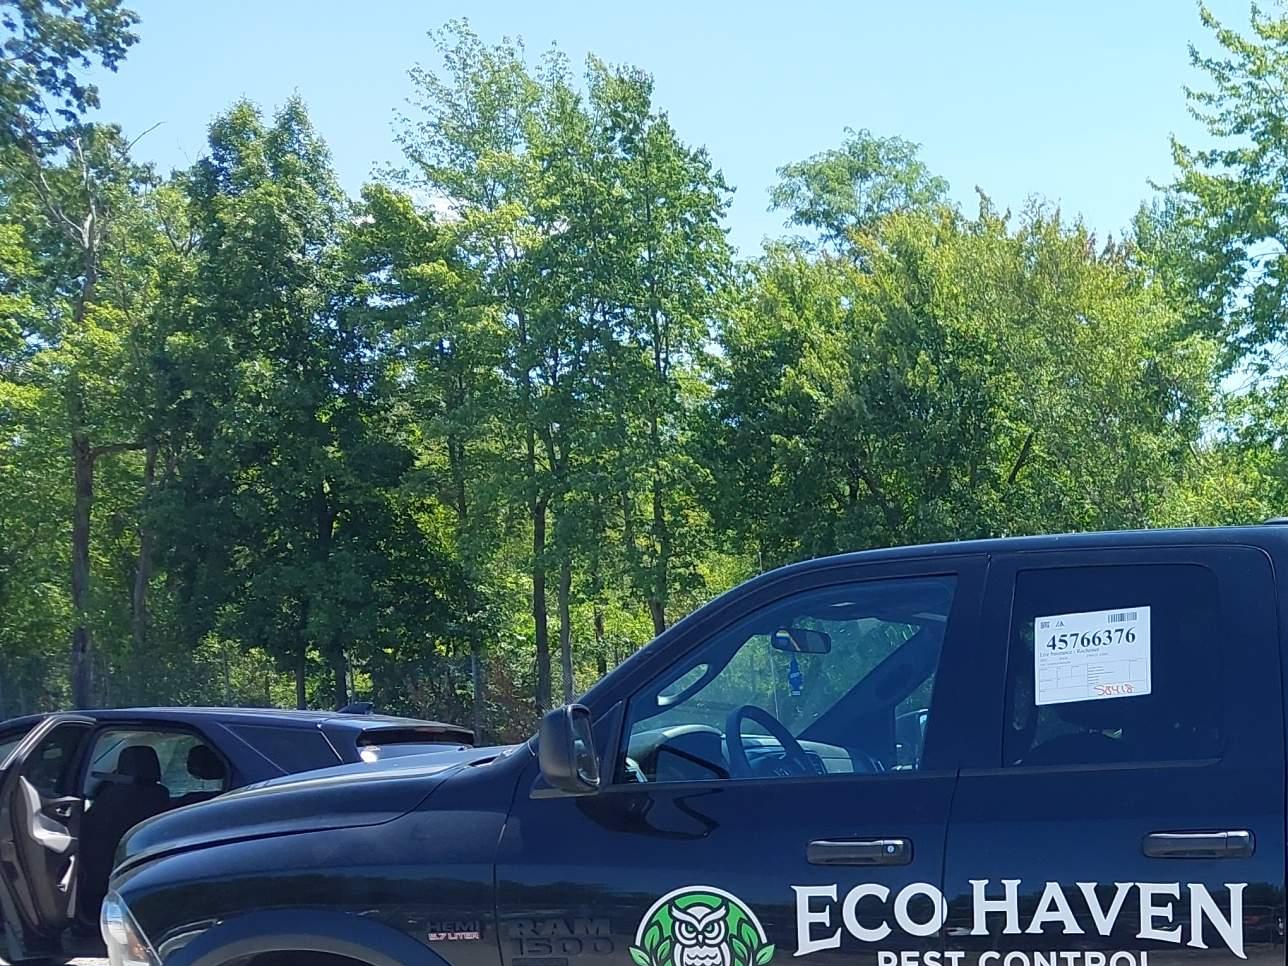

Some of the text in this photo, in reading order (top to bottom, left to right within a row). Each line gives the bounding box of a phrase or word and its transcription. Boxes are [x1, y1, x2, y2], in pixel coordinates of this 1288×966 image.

[1046, 627, 1136, 650] 45766376
[510, 918, 612, 936] RAM
[790, 879, 1248, 960] ECO HAVEN
[510, 937, 615, 956] 1500
